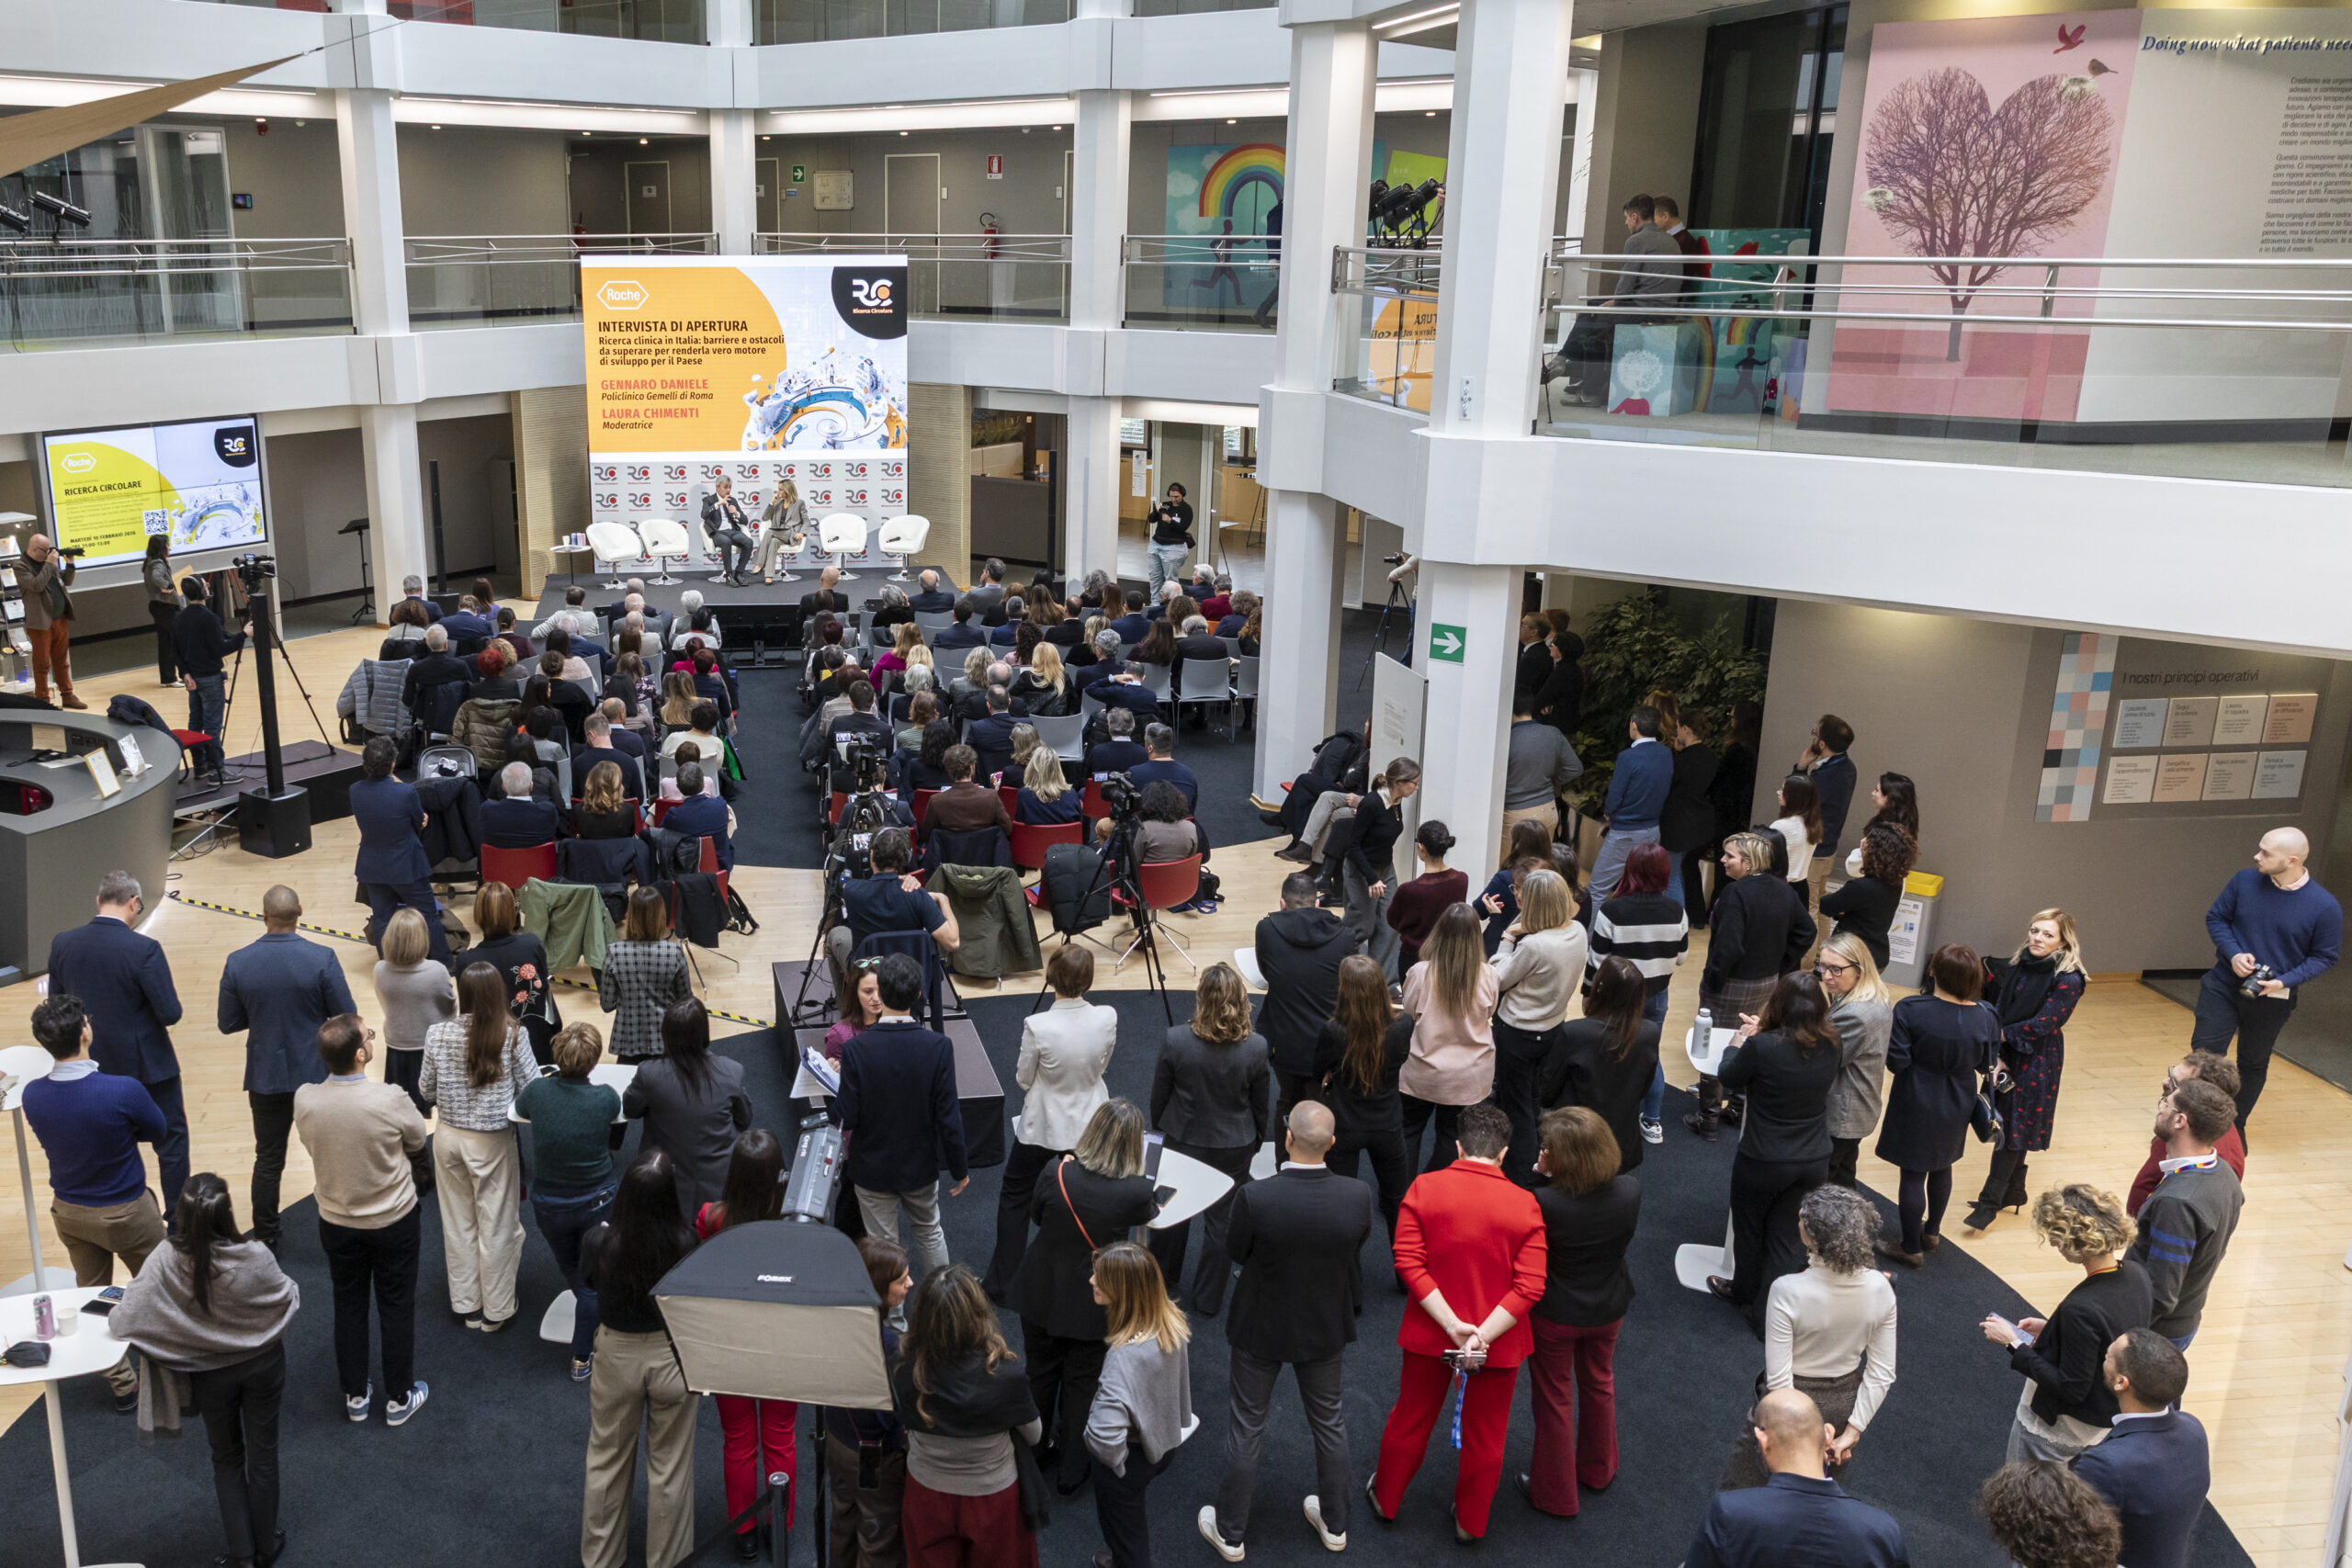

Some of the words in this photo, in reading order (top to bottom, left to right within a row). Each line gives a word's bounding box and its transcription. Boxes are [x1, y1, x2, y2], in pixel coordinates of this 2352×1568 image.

[2142, 35, 2187, 55] Doing
[2190, 40, 2218, 51] now
[2225, 34, 2260, 51] what
[2262, 36, 2322, 55] patients
[2326, 39, 2352, 51] nee
[606, 288, 640, 301] Roche
[598, 321, 667, 333] INTERVISTA
[671, 321, 683, 332] DI
[686, 321, 748, 332] APERTURA
[599, 336, 631, 345] Ricerca
[634, 335, 663, 345] clinica
[665, 335, 673, 344] in
[676, 335, 702, 344] Italia:
[704, 335, 740, 344] barriere
[750, 334, 785, 344] ostacoli
[599, 346, 611, 355] da
[613, 347, 652, 356] superare
[654, 348, 670, 356] per
[673, 345, 710, 355] renderla
[734, 346, 766, 355] motore
[600, 356, 608, 366] di
[611, 355, 649, 367] sviluppo
[651, 357, 666, 367] per
[669, 356, 674, 365] il
[676, 356, 702, 365] Paese
[601, 379, 657, 389] GENNARO
[661, 379, 708, 389] DANIELE
[602, 392, 645, 400] Policlinico
[647, 391, 678, 400] Gemelli
[680, 391, 687, 400] di
[602, 409, 640, 419] LAURA
[643, 408, 698, 418] CHIMENTI
[603, 421, 653, 429] Moderatrice
[67, 459, 91, 468] Roche
[64, 486, 98, 496] RICERCA
[100, 480, 141, 491] CIRCOLARE
[2130, 671, 2162, 684] nostri
[2165, 671, 2207, 685] principi
[2209, 669, 2259, 683] operativi
